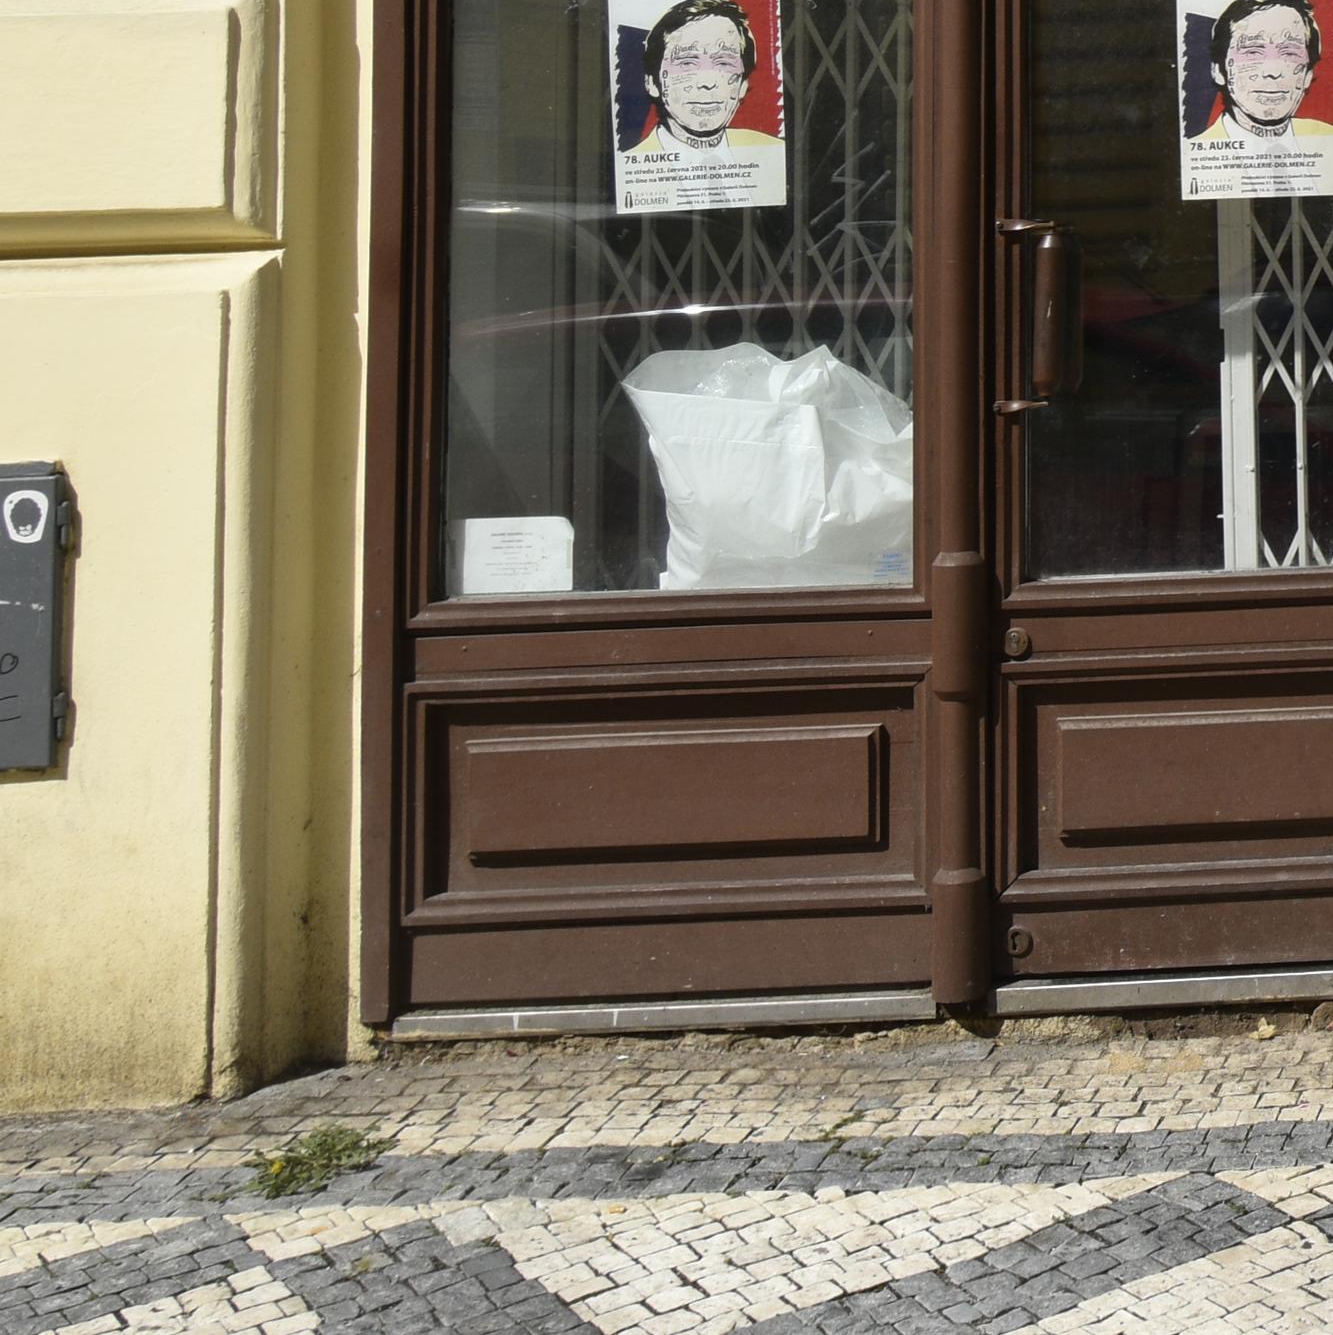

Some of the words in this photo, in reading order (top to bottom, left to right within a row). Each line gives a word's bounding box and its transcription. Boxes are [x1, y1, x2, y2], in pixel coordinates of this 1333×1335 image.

[1190, 143, 1206, 151] 78.
[1209, 141, 1245, 150] AUKCE
[625, 156, 641, 164] 78.
[644, 153, 680, 163] AUKCE
[1200, 184, 1233, 192] DOLMEN
[635, 197, 668, 206] DOLMEN
